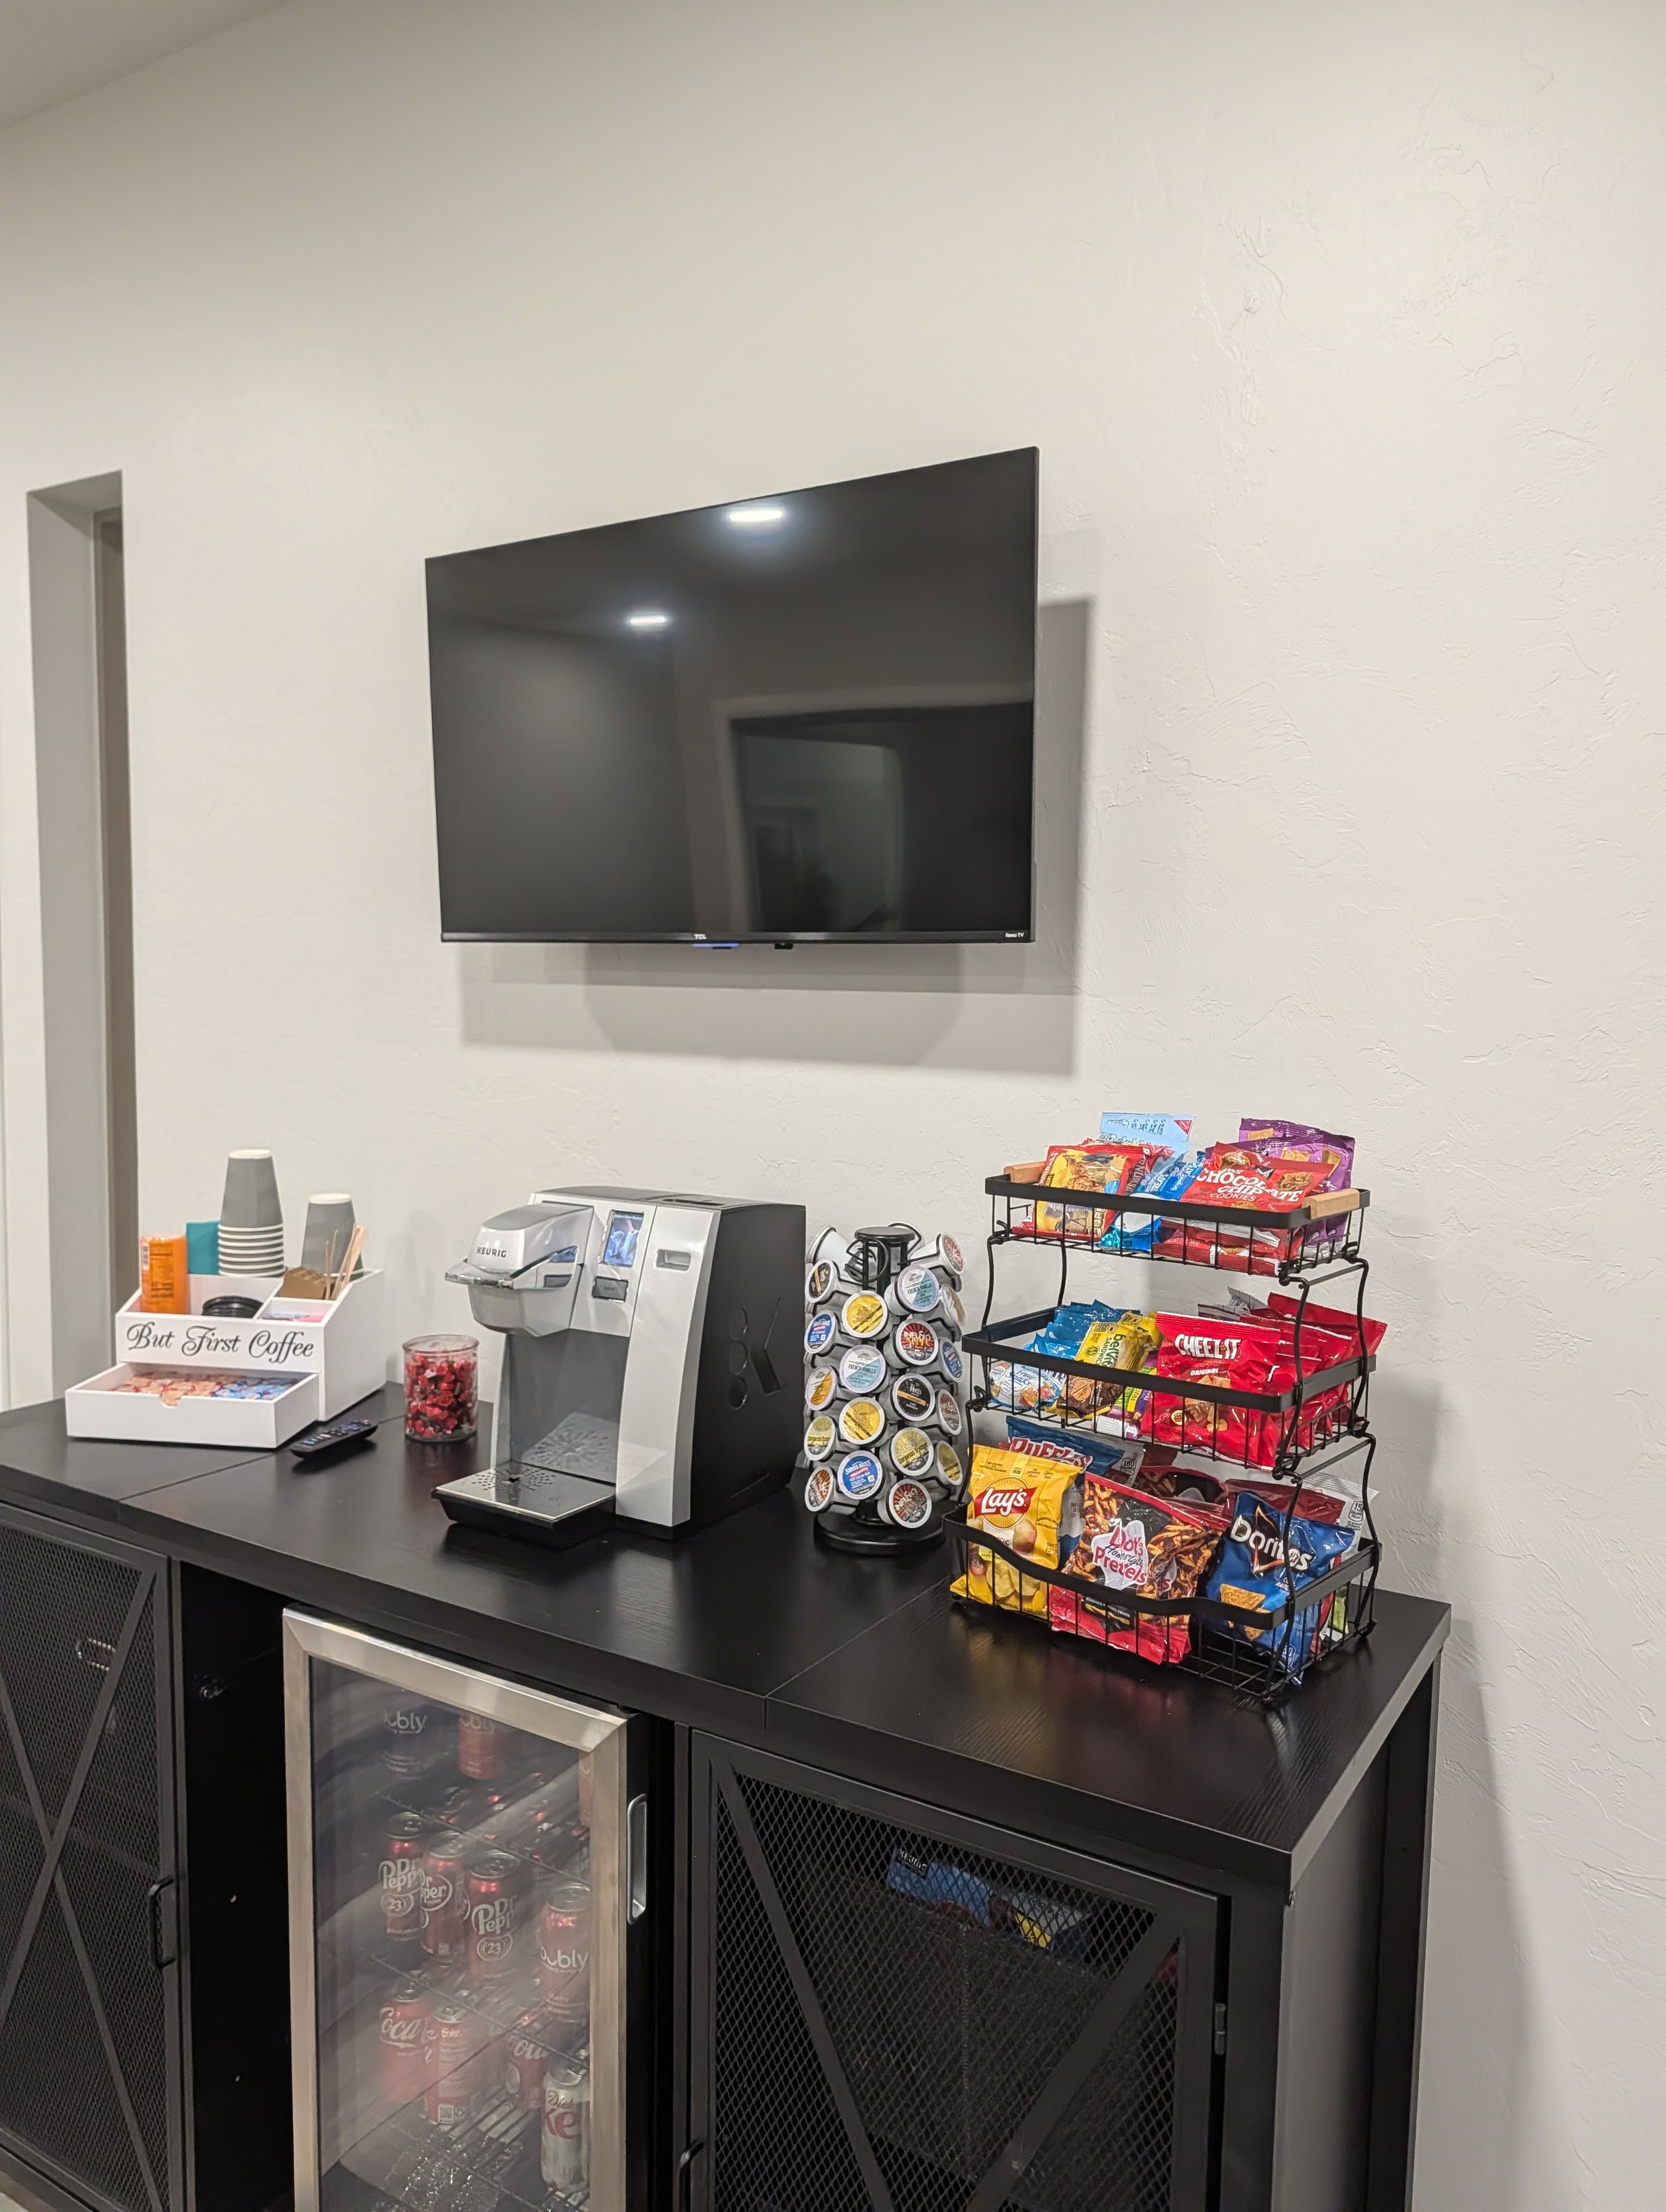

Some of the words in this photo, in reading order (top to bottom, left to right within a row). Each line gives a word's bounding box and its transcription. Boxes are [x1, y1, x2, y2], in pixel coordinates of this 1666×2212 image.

[1196, 1168, 1303, 1202] CHOCOLATE
[1209, 1192, 1257, 1202] COOKIES
[1217, 1185, 1265, 1196] CHIP
[477, 1246, 507, 1258] KEURIG
[126, 1321, 175, 1351] But
[182, 1325, 241, 1356] First
[248, 1329, 315, 1365] Coffee
[1190, 1368, 1219, 1376] ORIGINAL
[981, 1488, 1027, 1516] Lay's
[1110, 1527, 1143, 1556] Dot's
[1231, 1516, 1313, 1571] Doritos
[1094, 1546, 1147, 1584] Pretels
[379, 1860, 421, 1892] Pepp
[388, 1899, 402, 1911] 23
[472, 1904, 515, 1935] Pepp
[488, 1943, 503, 1954] 23
